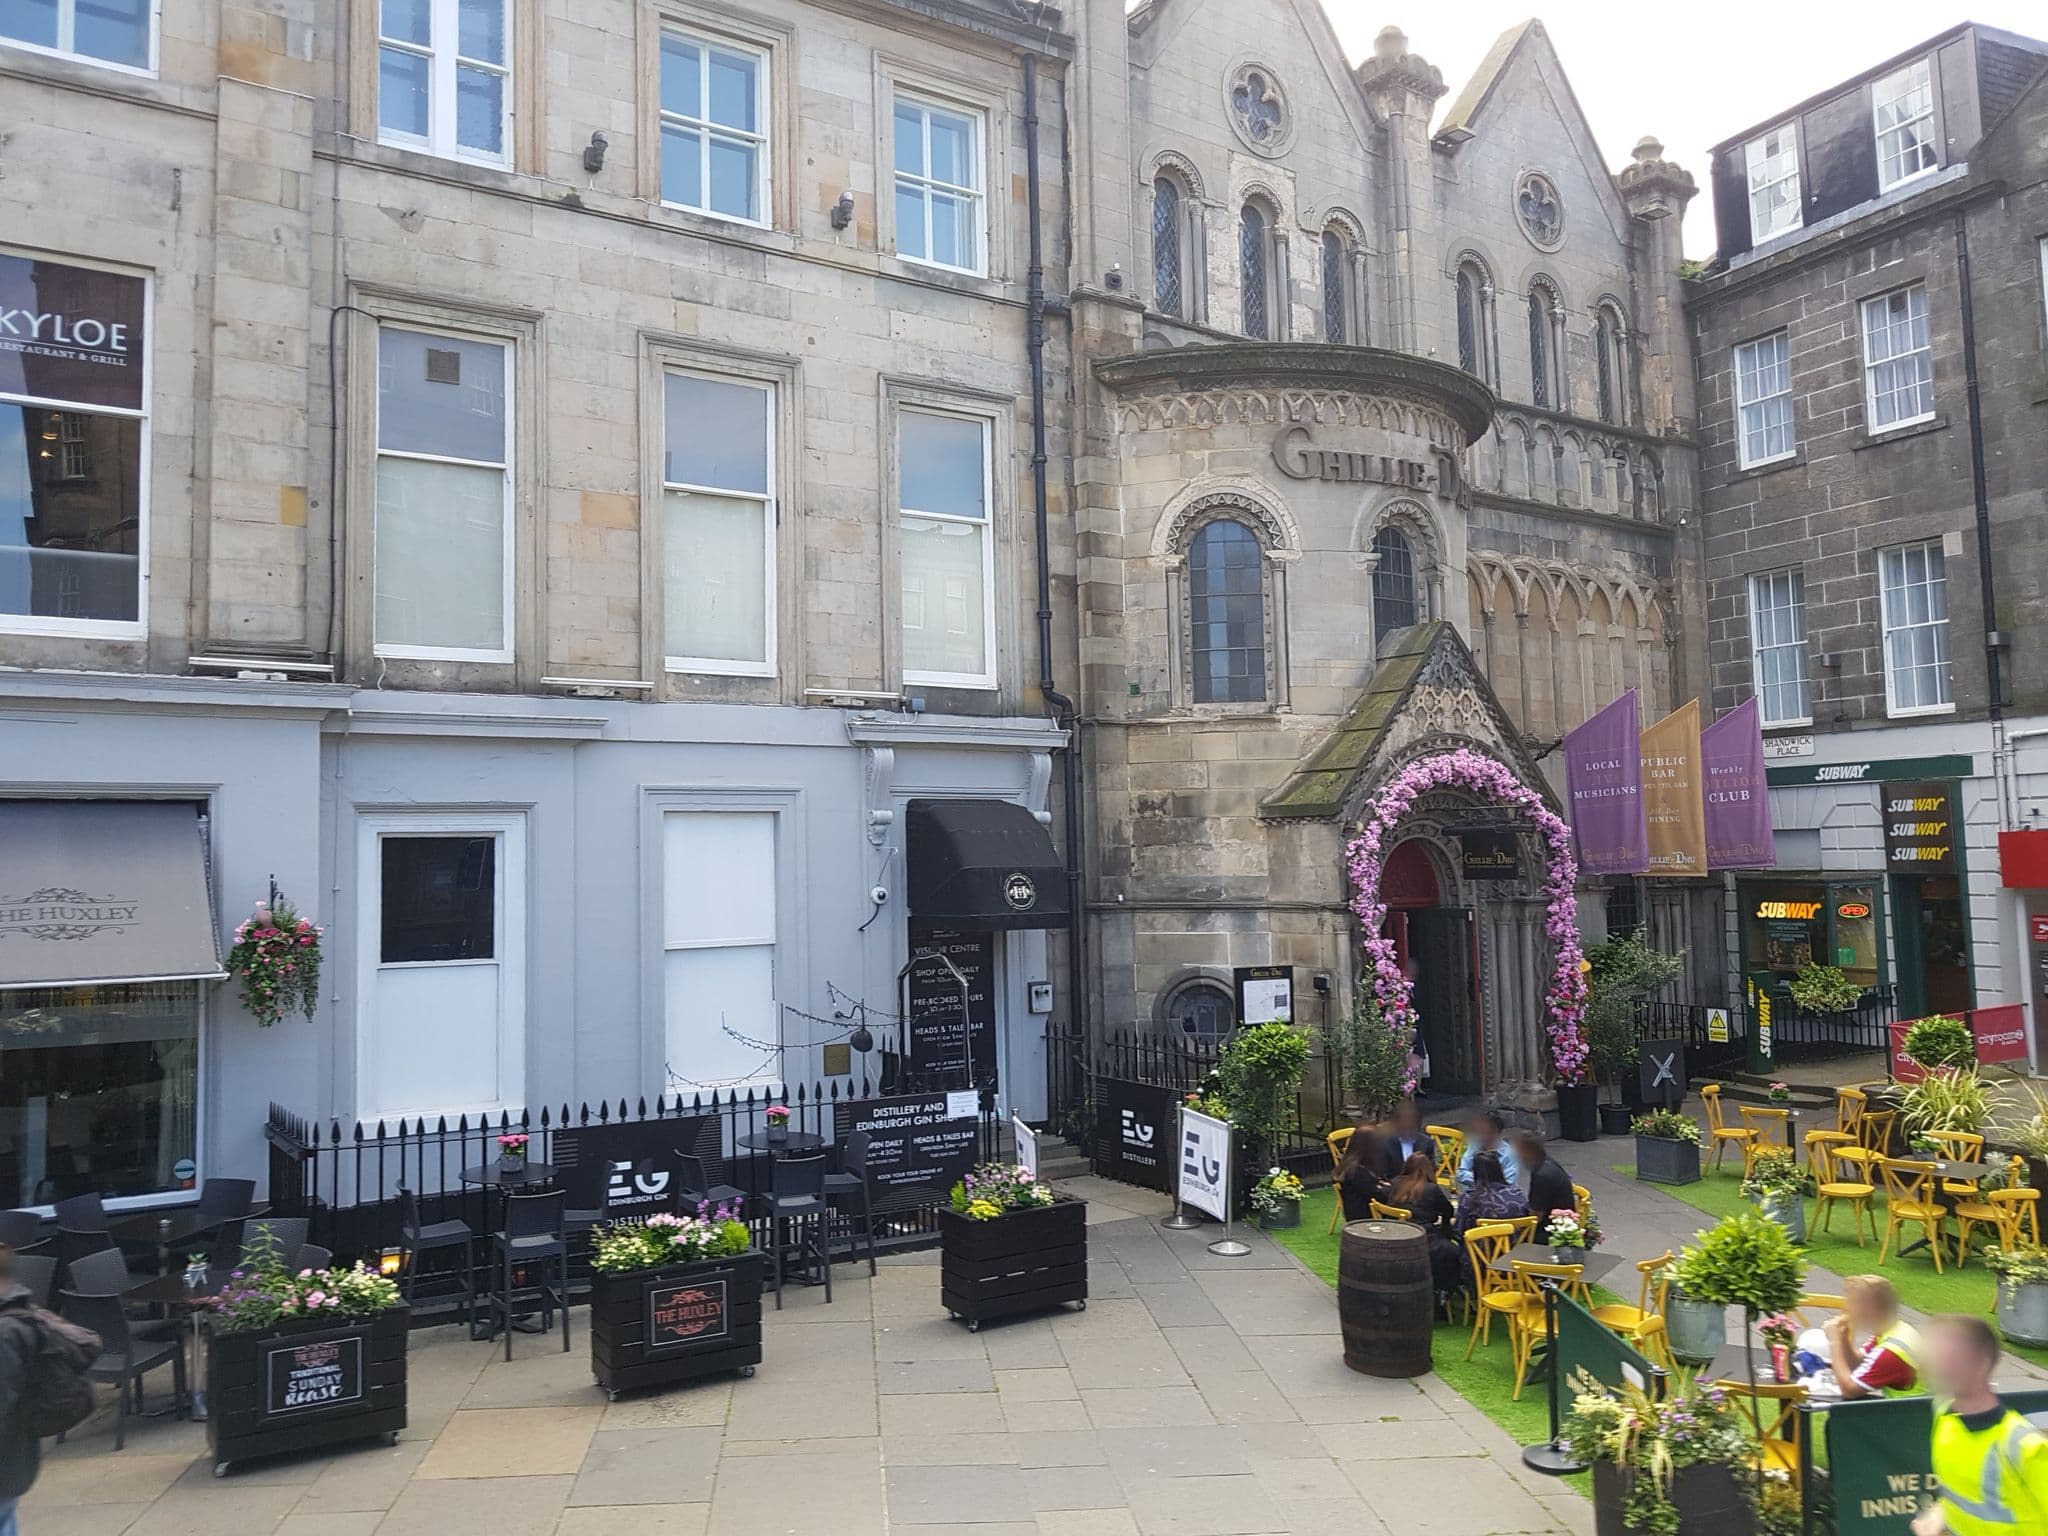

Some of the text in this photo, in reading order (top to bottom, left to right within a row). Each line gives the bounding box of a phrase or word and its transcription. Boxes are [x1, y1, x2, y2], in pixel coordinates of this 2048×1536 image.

[0, 306, 128, 351] KYLOE
[78, 352, 88, 361] &
[91, 354, 128, 367] GRILL
[1765, 736, 1811, 747] SHANDWICK
[1777, 746, 1800, 756] PLACE
[1586, 759, 1621, 771] LOCAL
[1640, 756, 1687, 767] PUBLIC
[1651, 769, 1676, 778] BAR
[1711, 765, 1744, 775] Weekly
[1815, 764, 1870, 781] SUBWAY
[1574, 785, 1637, 799] MUSICIANS
[1709, 790, 1750, 803] CLUB
[1887, 797, 1945, 813] SUBWAY
[1649, 815, 1681, 823] DINING
[1889, 822, 1948, 837] SUBWAY
[1892, 846, 1950, 861] SUBWAY
[40, 906, 139, 921] HUXLEY
[1756, 902, 1822, 919] SUBWAY
[1840, 905, 1867, 916] OPEN
[950, 943, 980, 953] CENTRE
[916, 968, 936, 977] SHOP
[915, 1026, 939, 1035] HEADS
[948, 1024, 967, 1032] TALE
[970, 1022, 984, 1030] BAR
[1759, 988, 1771, 1058] SUBWAY
[873, 1105, 921, 1118] DISTILLERY
[924, 1102, 944, 1113] AND
[856, 1118, 911, 1131] EDINBURGH
[914, 1115, 932, 1125] GIN
[885, 1139, 904, 1148] DAILY
[913, 1136, 934, 1145] HEADS
[943, 1132, 960, 1141] TALES
[962, 1131, 975, 1139] BAR
[1122, 1151, 1156, 1166] DISTILLERY
[609, 1195, 652, 1206] EDINBURGH
[288, 1373, 343, 1393] SUNDAY
[1888, 1473, 1920, 1492] WE
[1861, 1496, 1918, 1518] INNIS
